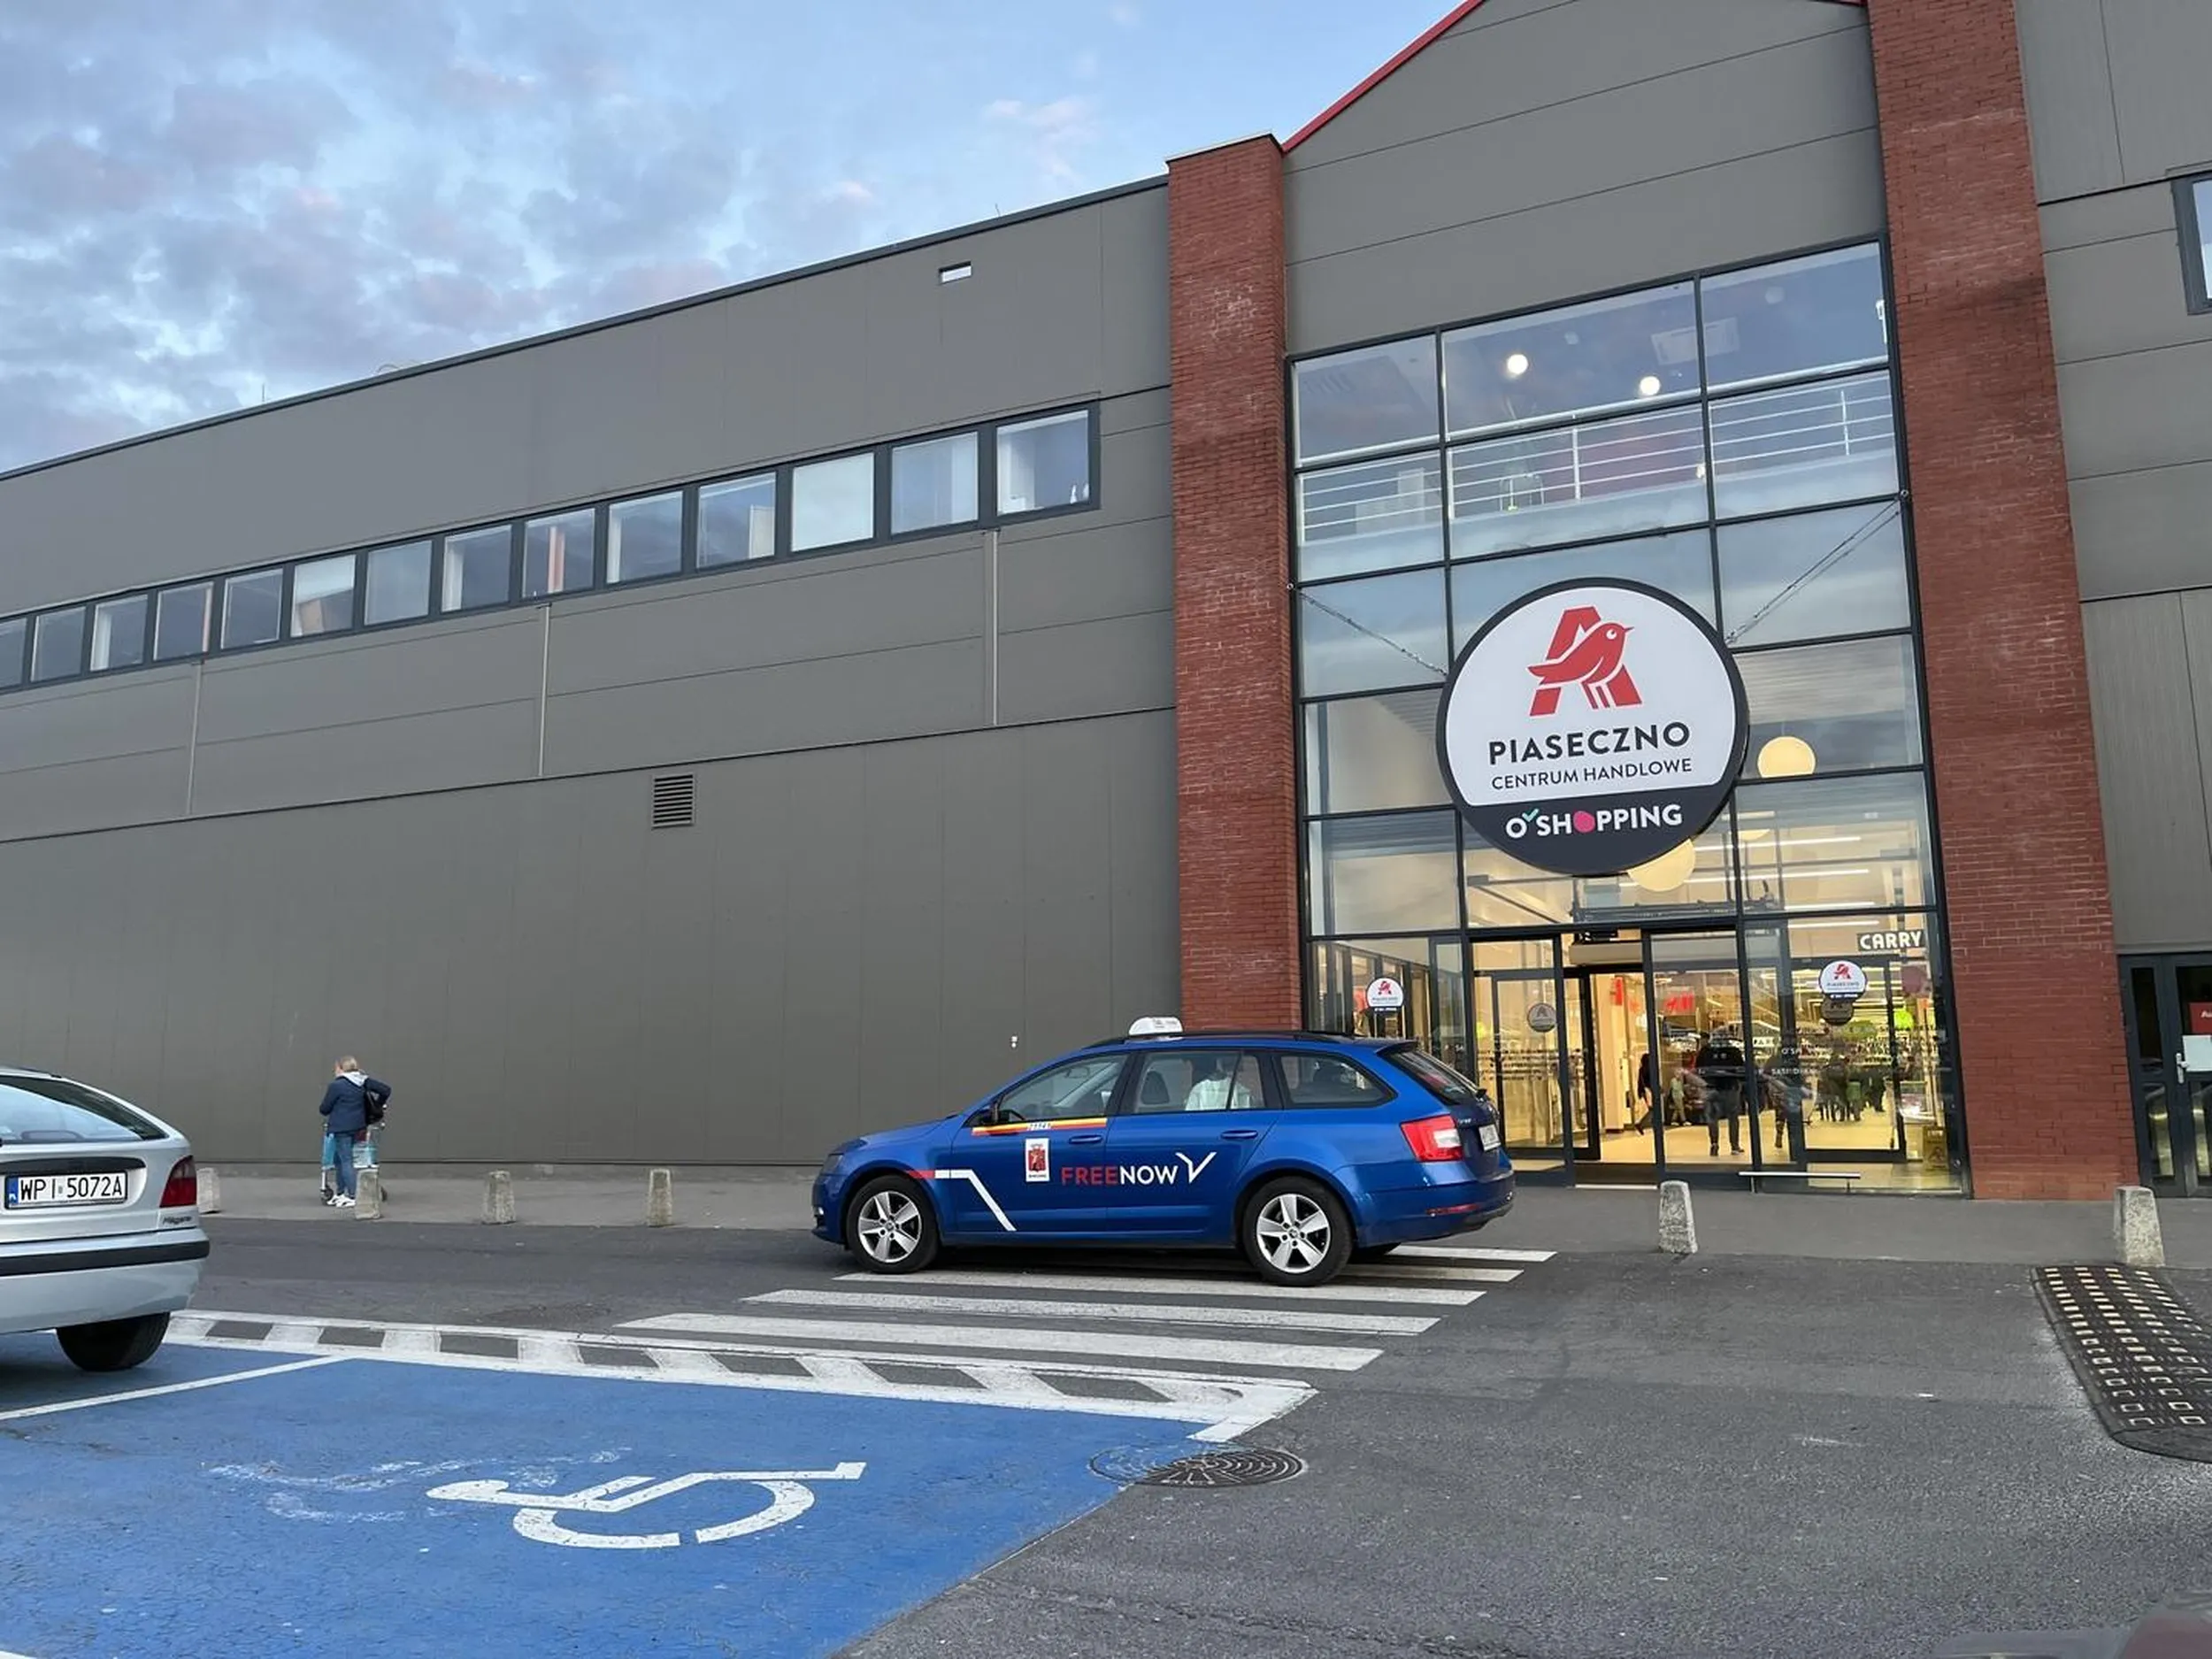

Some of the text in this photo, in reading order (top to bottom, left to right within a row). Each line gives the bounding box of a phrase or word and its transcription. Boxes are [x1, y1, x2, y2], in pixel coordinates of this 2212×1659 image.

[1488, 721, 1691, 765] PIASECZNO
[1491, 757, 1693, 790] CENTRUM HANDLOWE
[1859, 931, 1922, 950] CARRY
[1061, 1164, 1179, 1186] FREENOW
[19, 1176, 123, 1201] WPI 5072A
